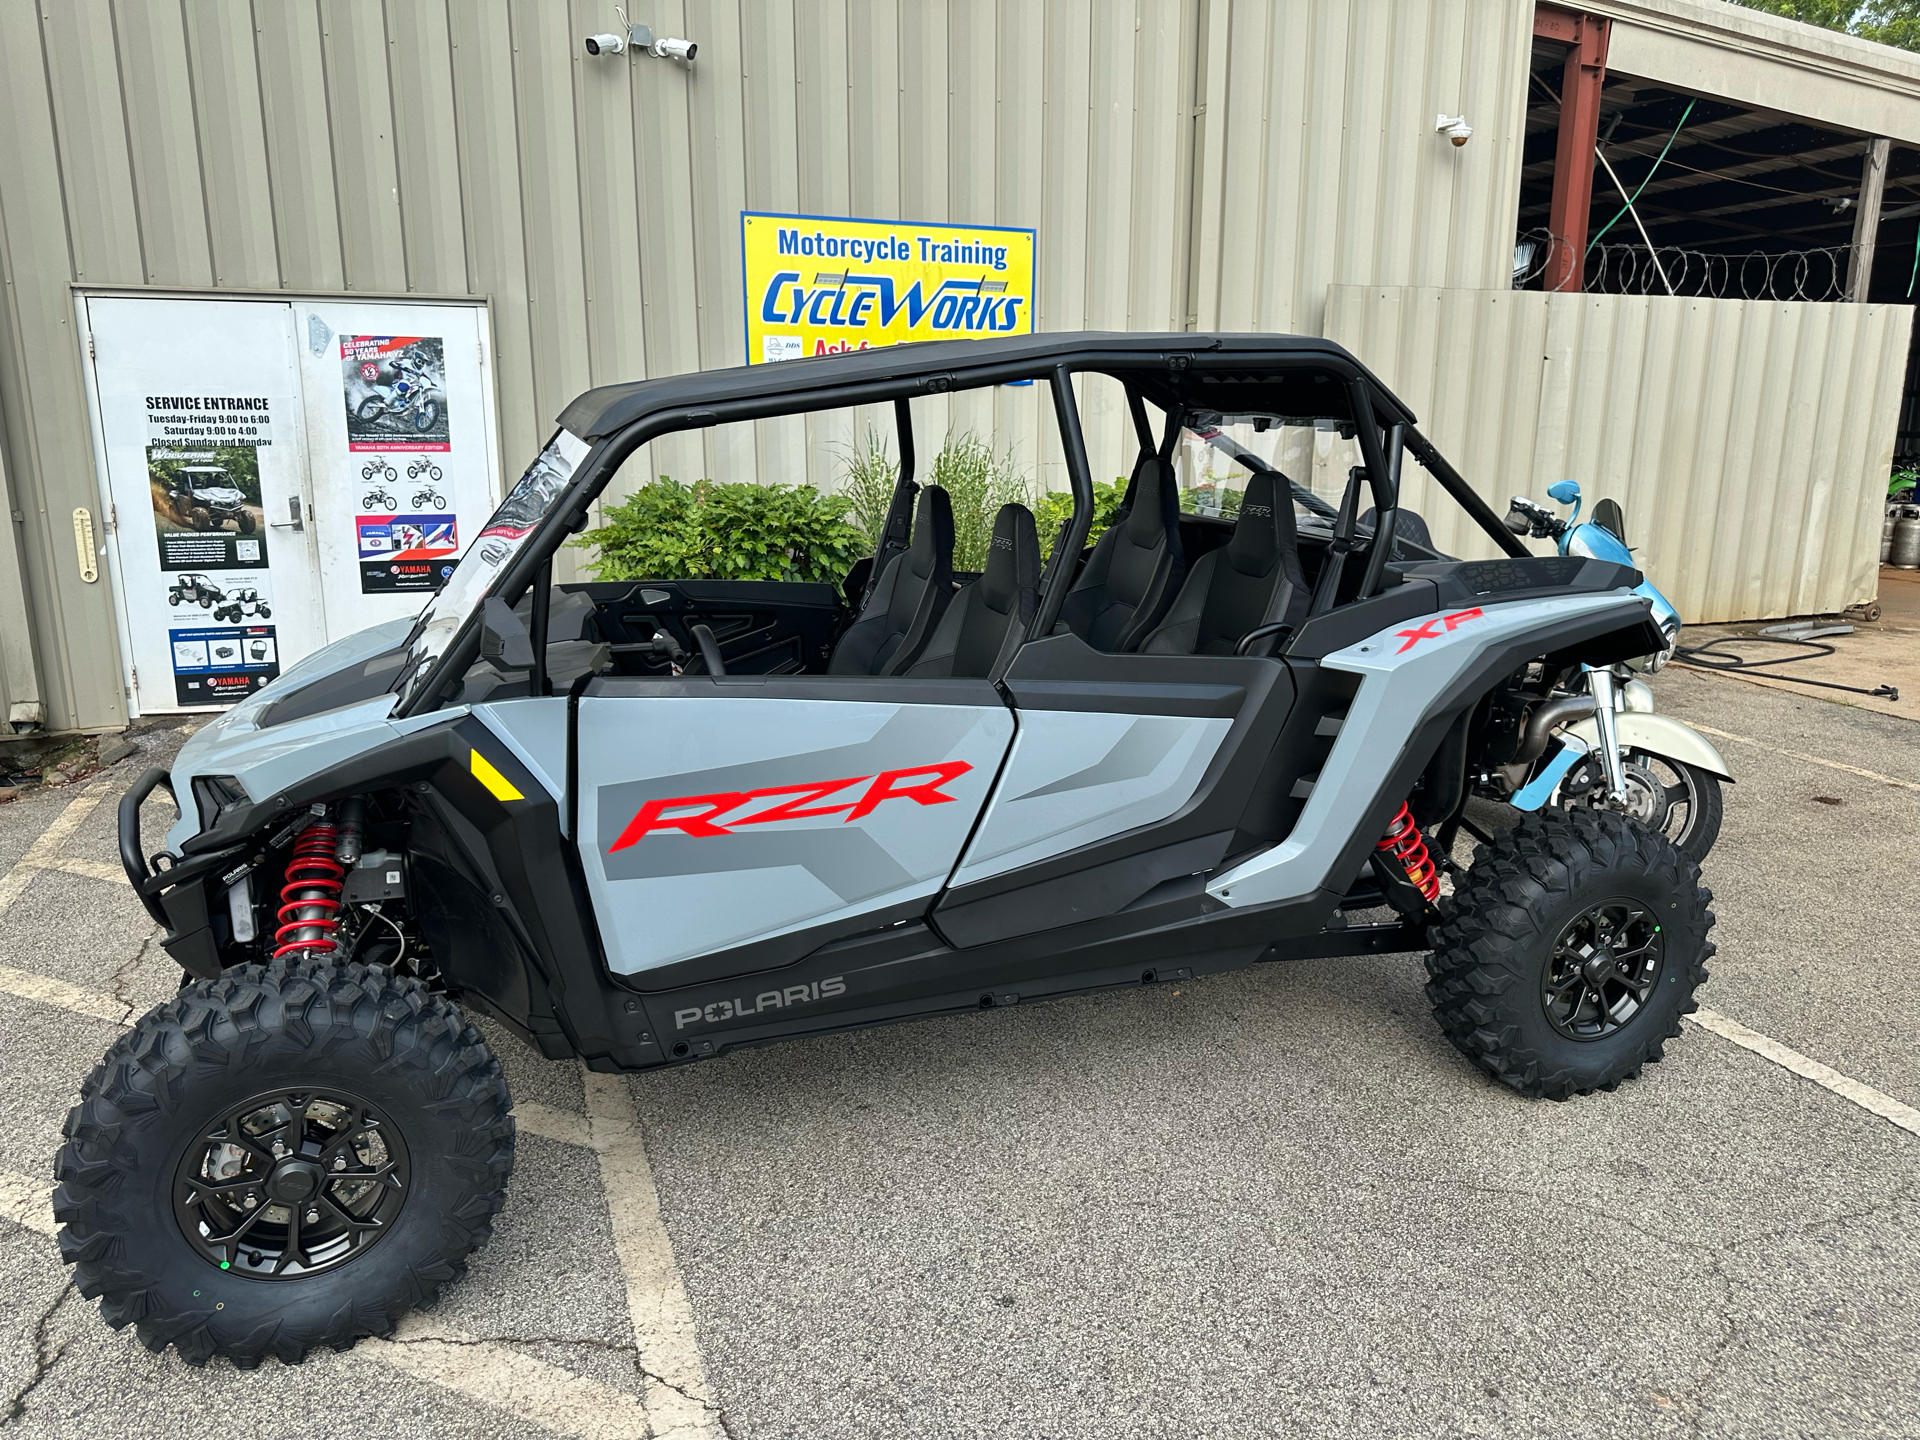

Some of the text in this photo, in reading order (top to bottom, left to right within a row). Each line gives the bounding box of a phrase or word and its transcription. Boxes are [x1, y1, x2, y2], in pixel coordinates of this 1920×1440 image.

[778, 229, 1007, 270] Motorcycle Training
[343, 339, 390, 348] CELEBRATING
[354, 346, 378, 355] YEARS
[357, 351, 391, 361] YAMAHA
[394, 350, 404, 358] YZ
[145, 396, 269, 411] SERVICE ENTRANCE
[148, 414, 270, 424] Tuesday-Friday 9:00 to 6:00
[164, 426, 257, 436] Saturday 9:00 to 4:00
[151, 438, 272, 447] Closed Sunday and Monday
[400, 565, 431, 573] YAMAHA
[1393, 607, 1484, 656] XP
[217, 677, 250, 685] YAMAHA
[606, 760, 975, 855] RZR
[222, 863, 248, 881] POLARIS
[673, 976, 847, 1030] POLARIS
